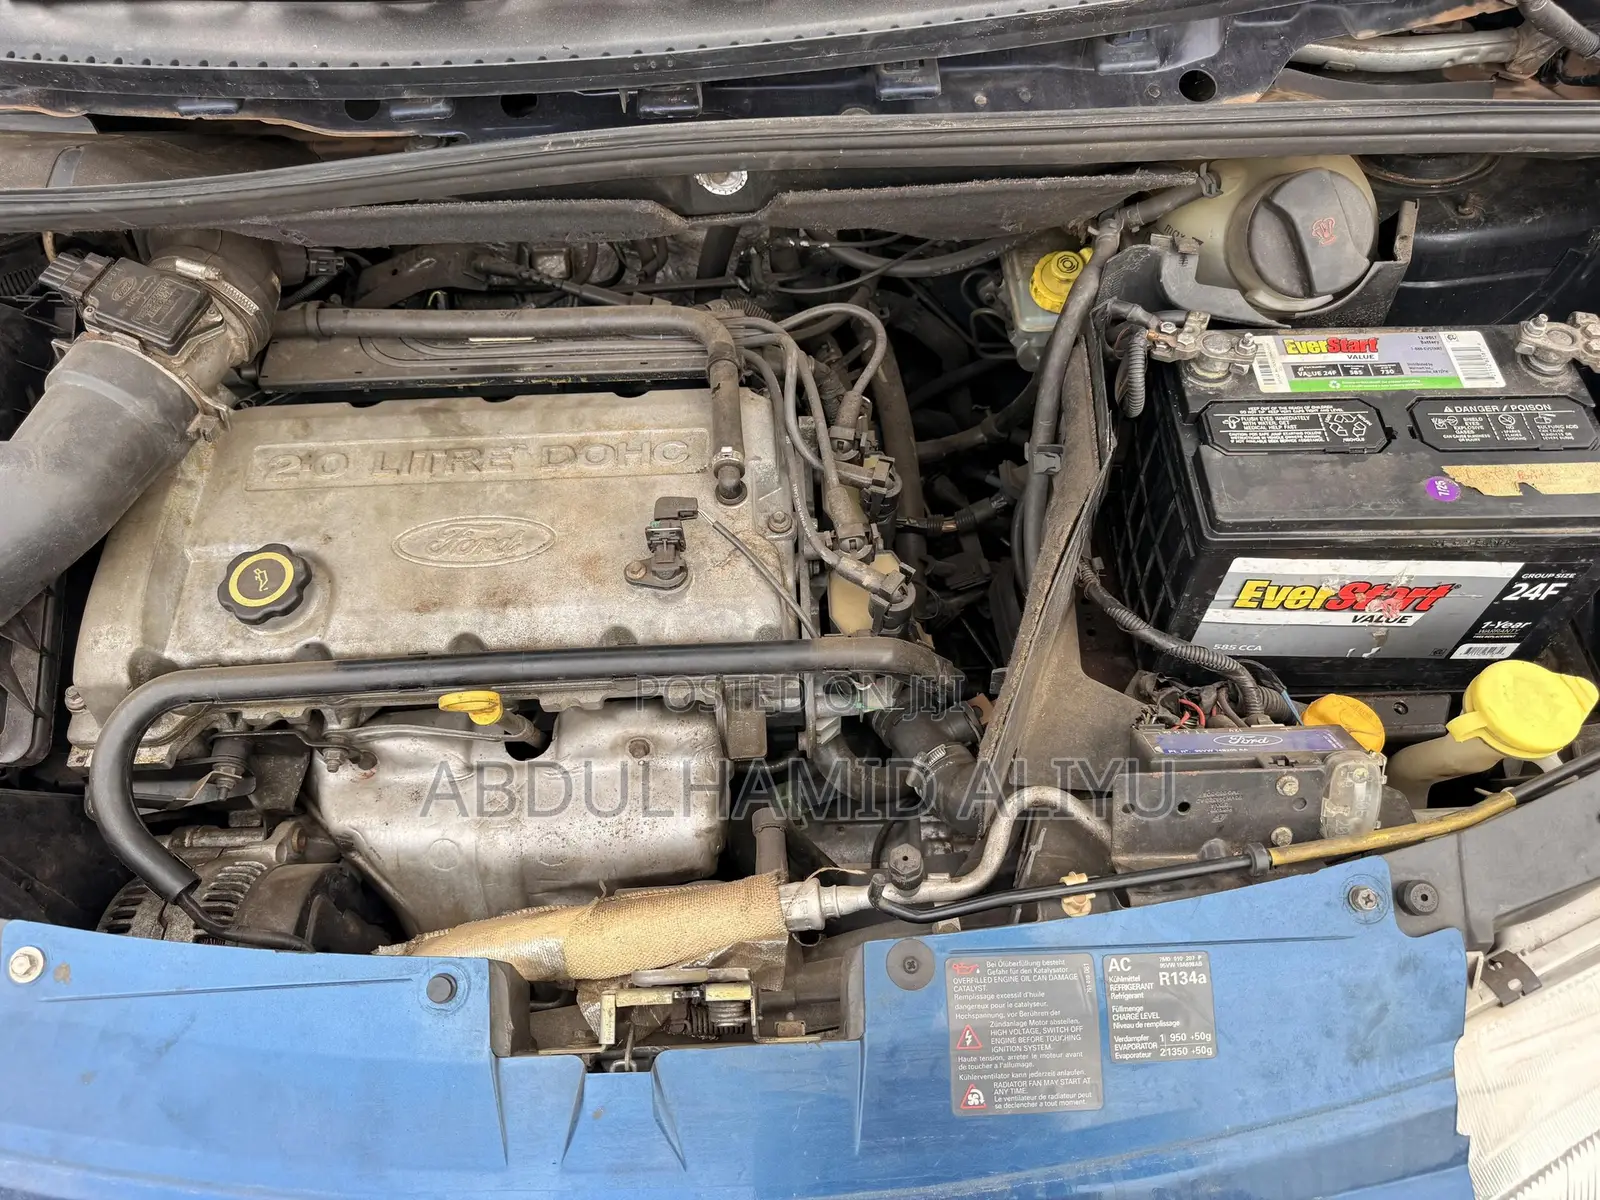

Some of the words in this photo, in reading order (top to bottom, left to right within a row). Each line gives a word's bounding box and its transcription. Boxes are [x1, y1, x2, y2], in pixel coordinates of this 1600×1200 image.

[1283, 337, 1378, 355] EverStart
[371, 445, 518, 477] LITRE
[540, 440, 690, 471] DOHC
[423, 523, 524, 557] Ford
[1232, 578, 1457, 612] EverStart
[1502, 582, 1568, 601] 24F
[1351, 614, 1413, 624] VALUE
[1481, 620, 1532, 629] 1-Year
[1238, 643, 1262, 651] CCA
[1228, 736, 1270, 744] Ford
[1108, 957, 1131, 972] AC
[987, 968, 1008, 976] Gefahr
[953, 975, 992, 984] OVERFILLED
[993, 975, 1019, 983] ENGINE
[1032, 974, 1047, 982] CAN
[1159, 971, 1207, 986] R134a
[1110, 982, 1154, 991] REFRIGERANT
[954, 993, 995, 1001] Remplissage
[955, 1003, 989, 1011] dangereux
[1112, 1005, 1143, 1013] Füllmenge
[1113, 1012, 1139, 1021] CHARGE
[990, 1020, 1027, 1028] Zündanlage
[1113, 1021, 1134, 1029] Niveau
[1144, 1020, 1180, 1028] remplissage
[991, 1028, 1007, 1036] HIGH
[1043, 1026, 1068, 1034] SWITCH
[991, 1036, 1017, 1045] ENGINE
[1018, 1036, 1045, 1044] BEFORE
[1114, 1035, 1149, 1043] Verdampfer
[1170, 1033, 1186, 1042] 950
[992, 1045, 1022, 1053] IGNITION
[1114, 1042, 1157, 1051] EVAPORATOR
[1166, 1047, 1188, 1056] 1350
[1028, 1071, 1056, 1079] jederzeit
[994, 1081, 1027, 1089] RADIATOR
[1004, 1094, 1037, 1102] ventilateur
[1078, 1092, 1092, 1100] peut
